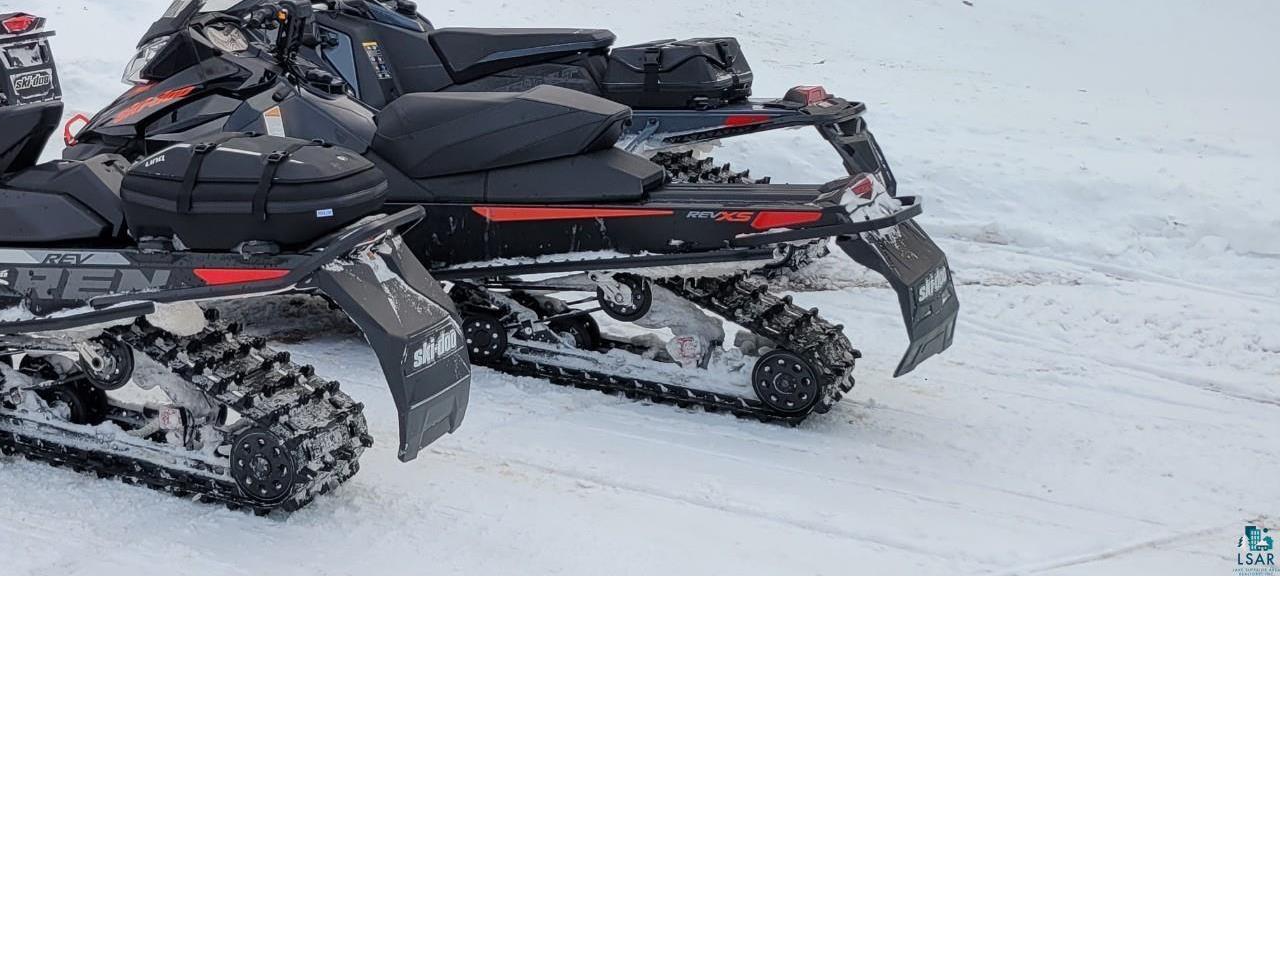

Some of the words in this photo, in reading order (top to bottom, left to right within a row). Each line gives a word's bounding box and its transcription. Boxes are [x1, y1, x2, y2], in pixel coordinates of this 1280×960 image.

[14, 73, 50, 90] ski-doo
[41, 253, 94, 265] REV
[918, 266, 948, 303] ski-doo
[413, 328, 457, 368] ski-doo
